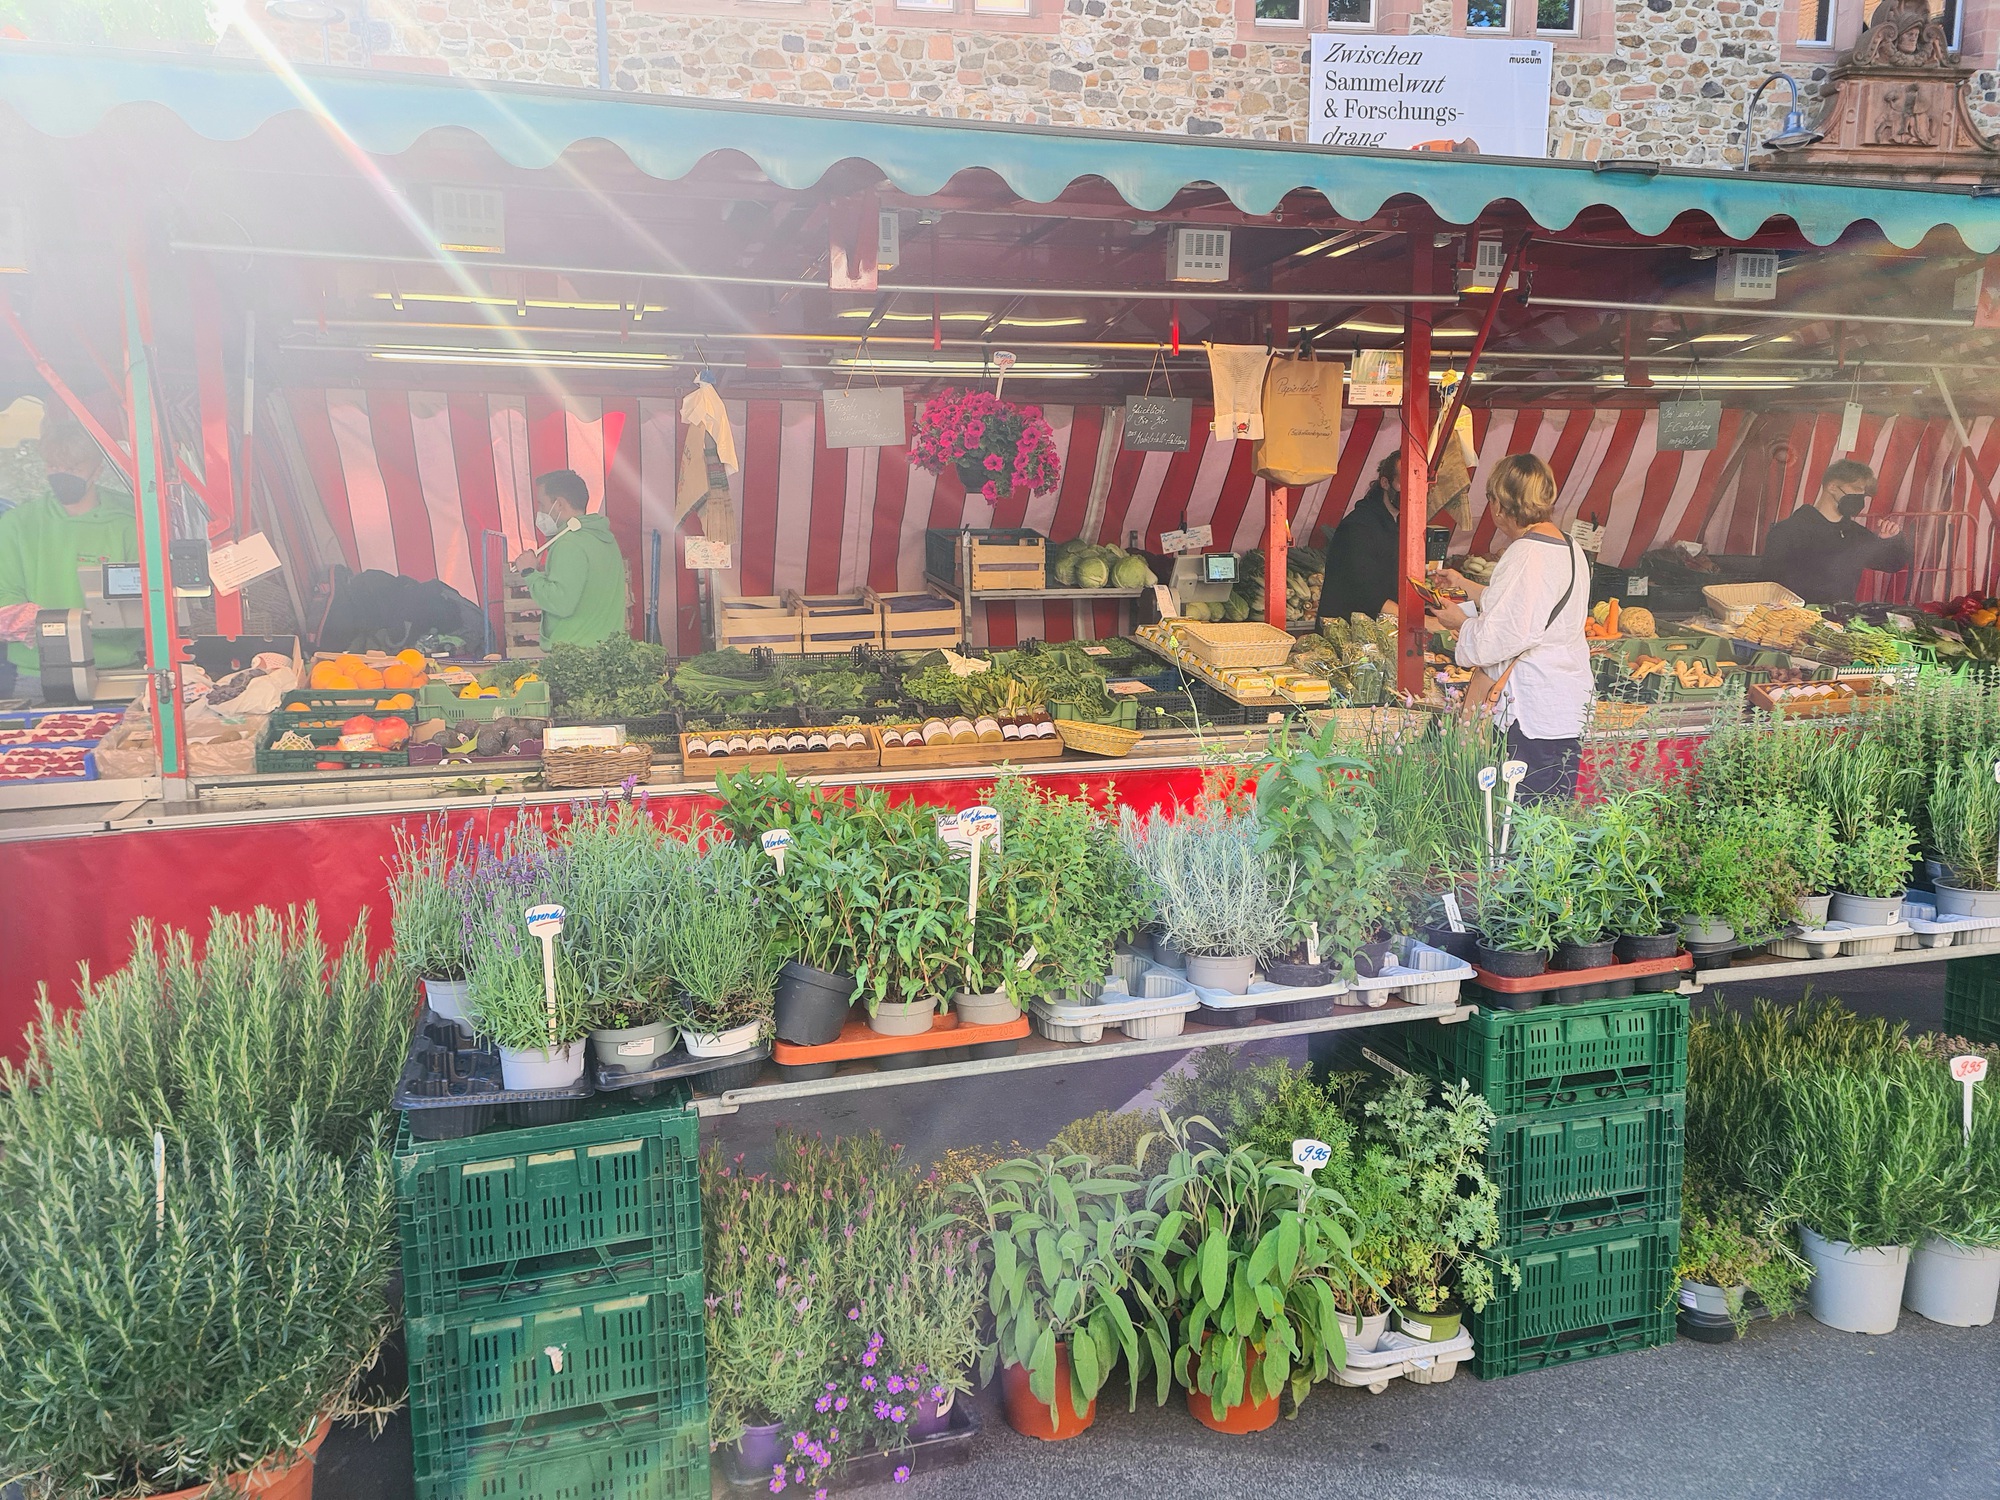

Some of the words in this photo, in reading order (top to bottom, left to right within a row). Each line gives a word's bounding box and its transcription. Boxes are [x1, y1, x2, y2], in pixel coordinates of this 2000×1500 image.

[1323, 42, 1423, 66] Zwischen
[1325, 70, 1447, 93] Sammelwut
[1324, 98, 1338, 118] &
[1344, 99, 1465, 126] Forschungs-
[1322, 126, 1387, 148] drang
[1298, 1145, 1331, 1162] 9.95
